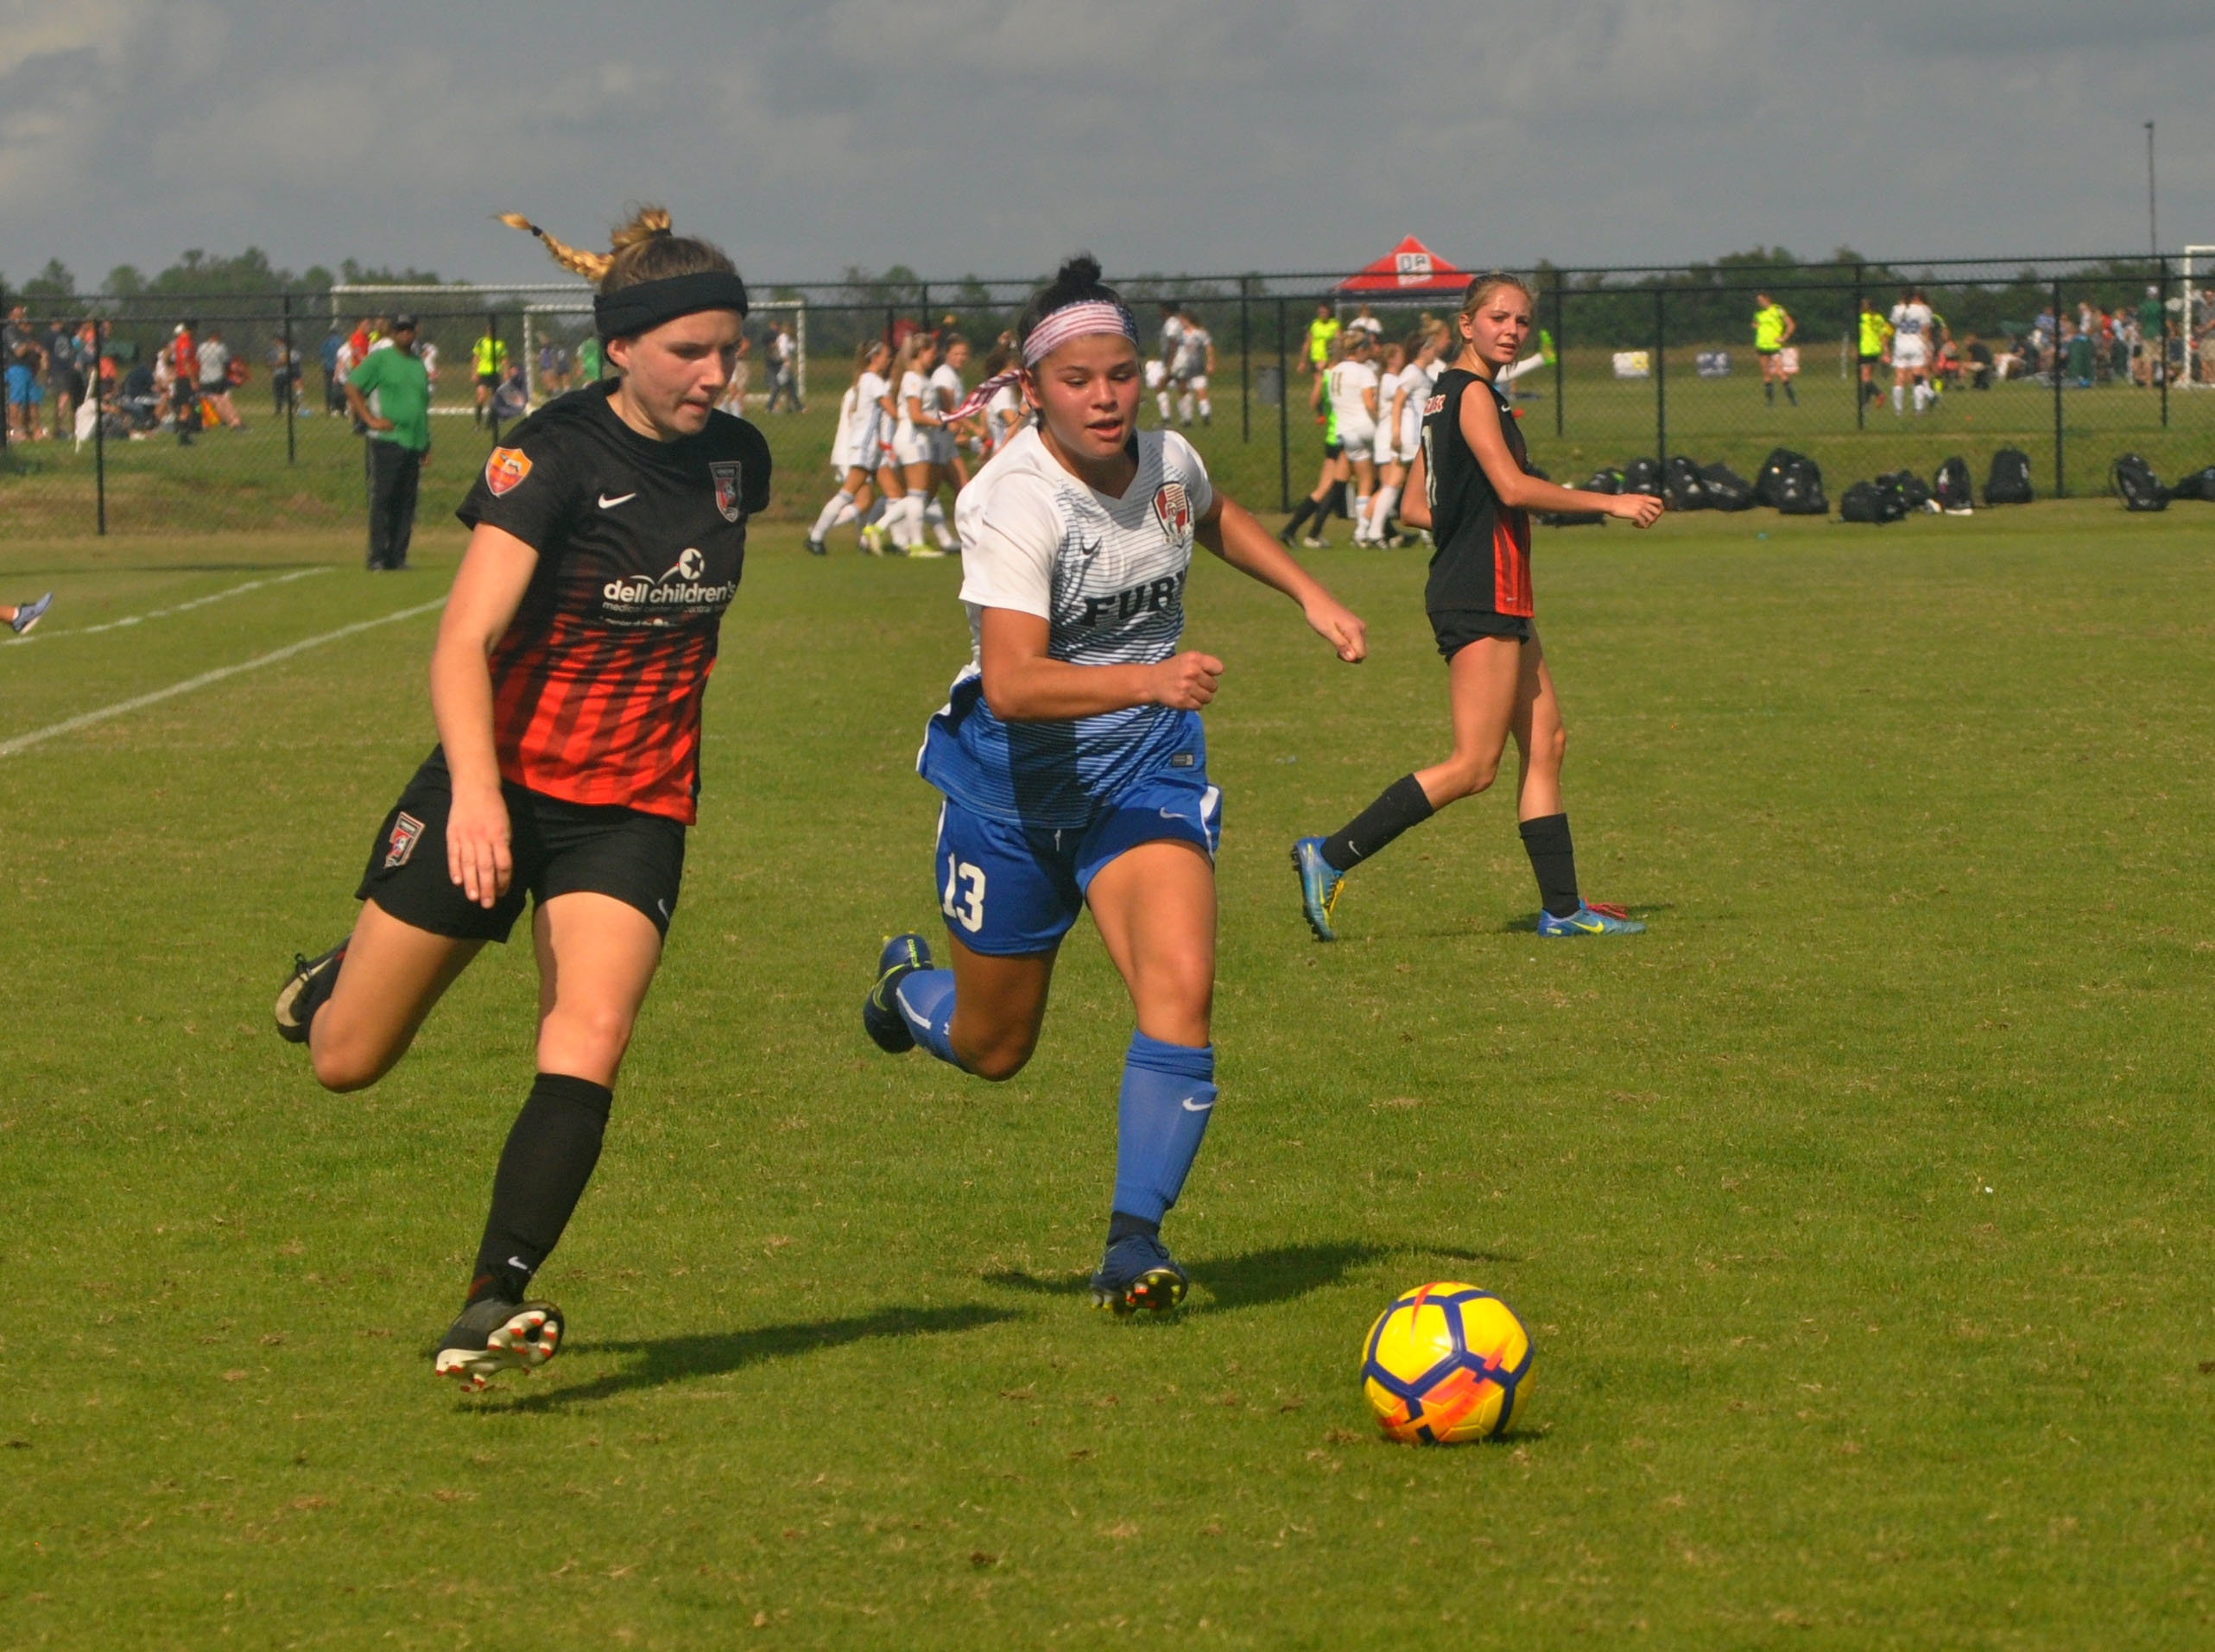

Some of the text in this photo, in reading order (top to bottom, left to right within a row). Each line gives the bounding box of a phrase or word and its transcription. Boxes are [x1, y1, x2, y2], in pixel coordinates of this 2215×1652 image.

[604, 579, 737, 604] dell children's
[943, 852, 986, 933] 13
